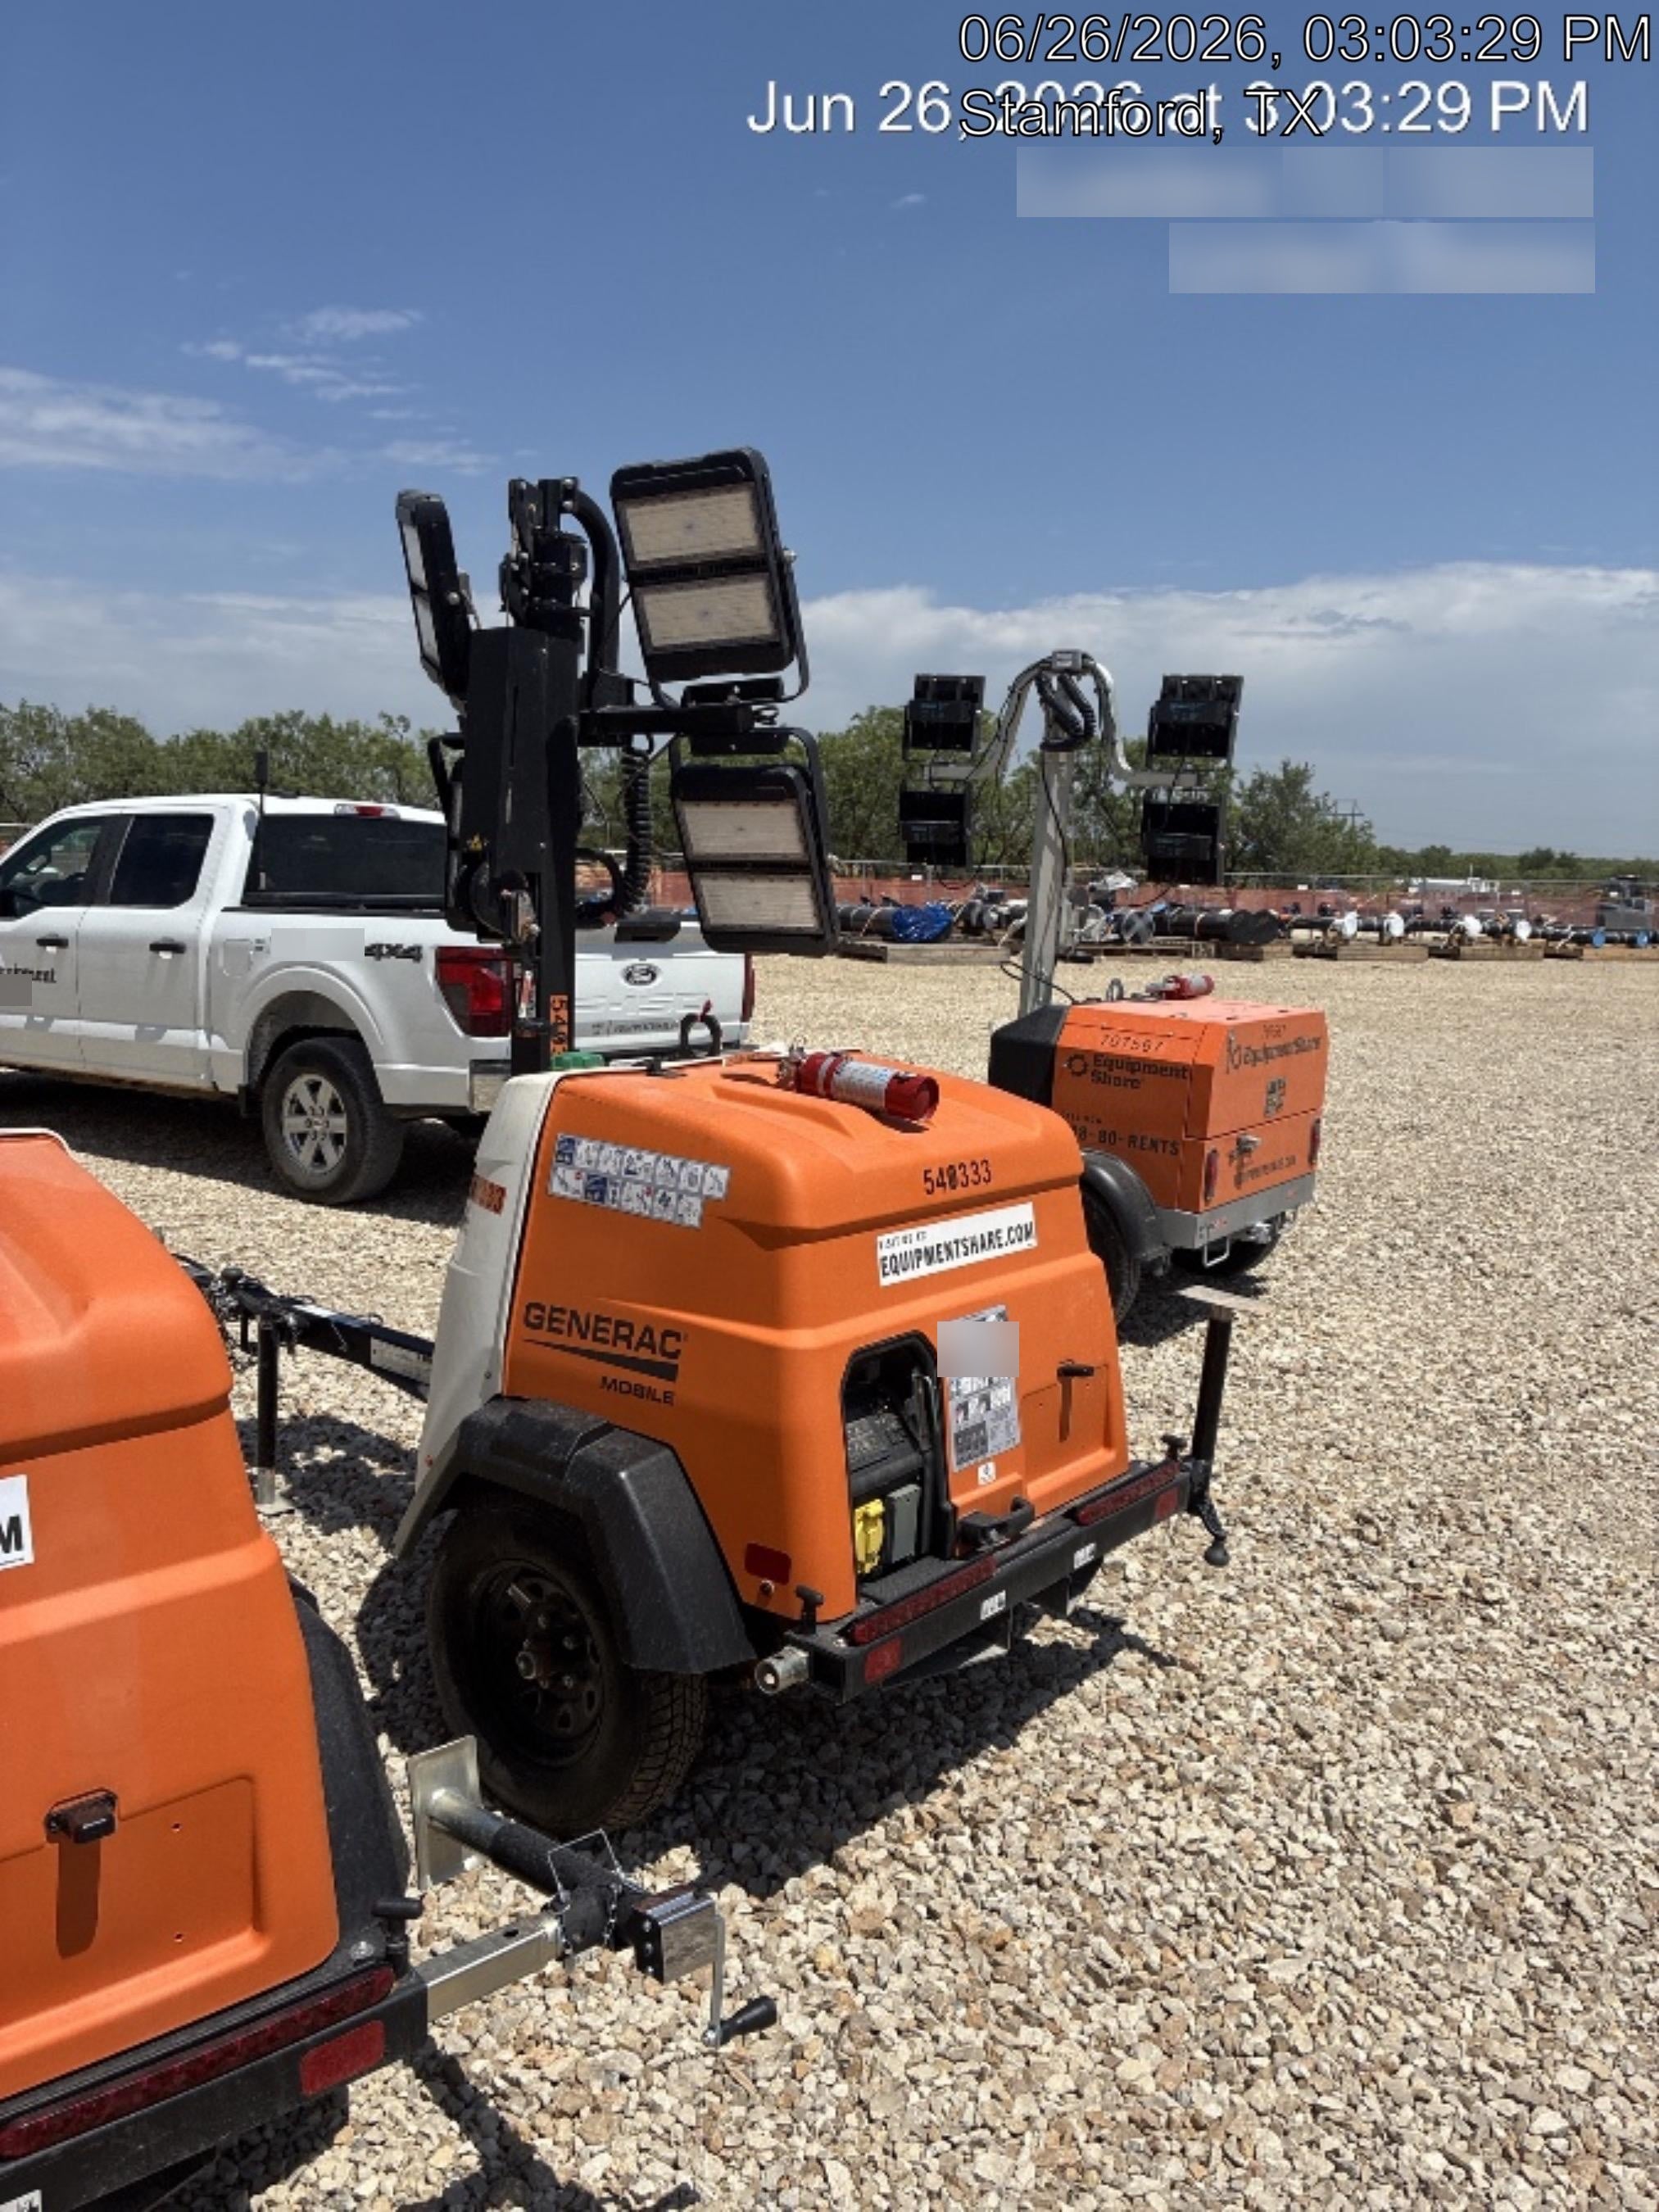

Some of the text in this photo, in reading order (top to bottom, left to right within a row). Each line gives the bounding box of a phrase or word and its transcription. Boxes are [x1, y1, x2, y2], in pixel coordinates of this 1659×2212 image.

[1090, 1068, 1141, 1090] Share
[1093, 1054, 1187, 1081] Equipment
[881, 1221, 1033, 1278] EQUIPMENTSHARE.COM
[523, 1301, 682, 1360] GENERAC
[598, 1376, 675, 1407] MOBILE
